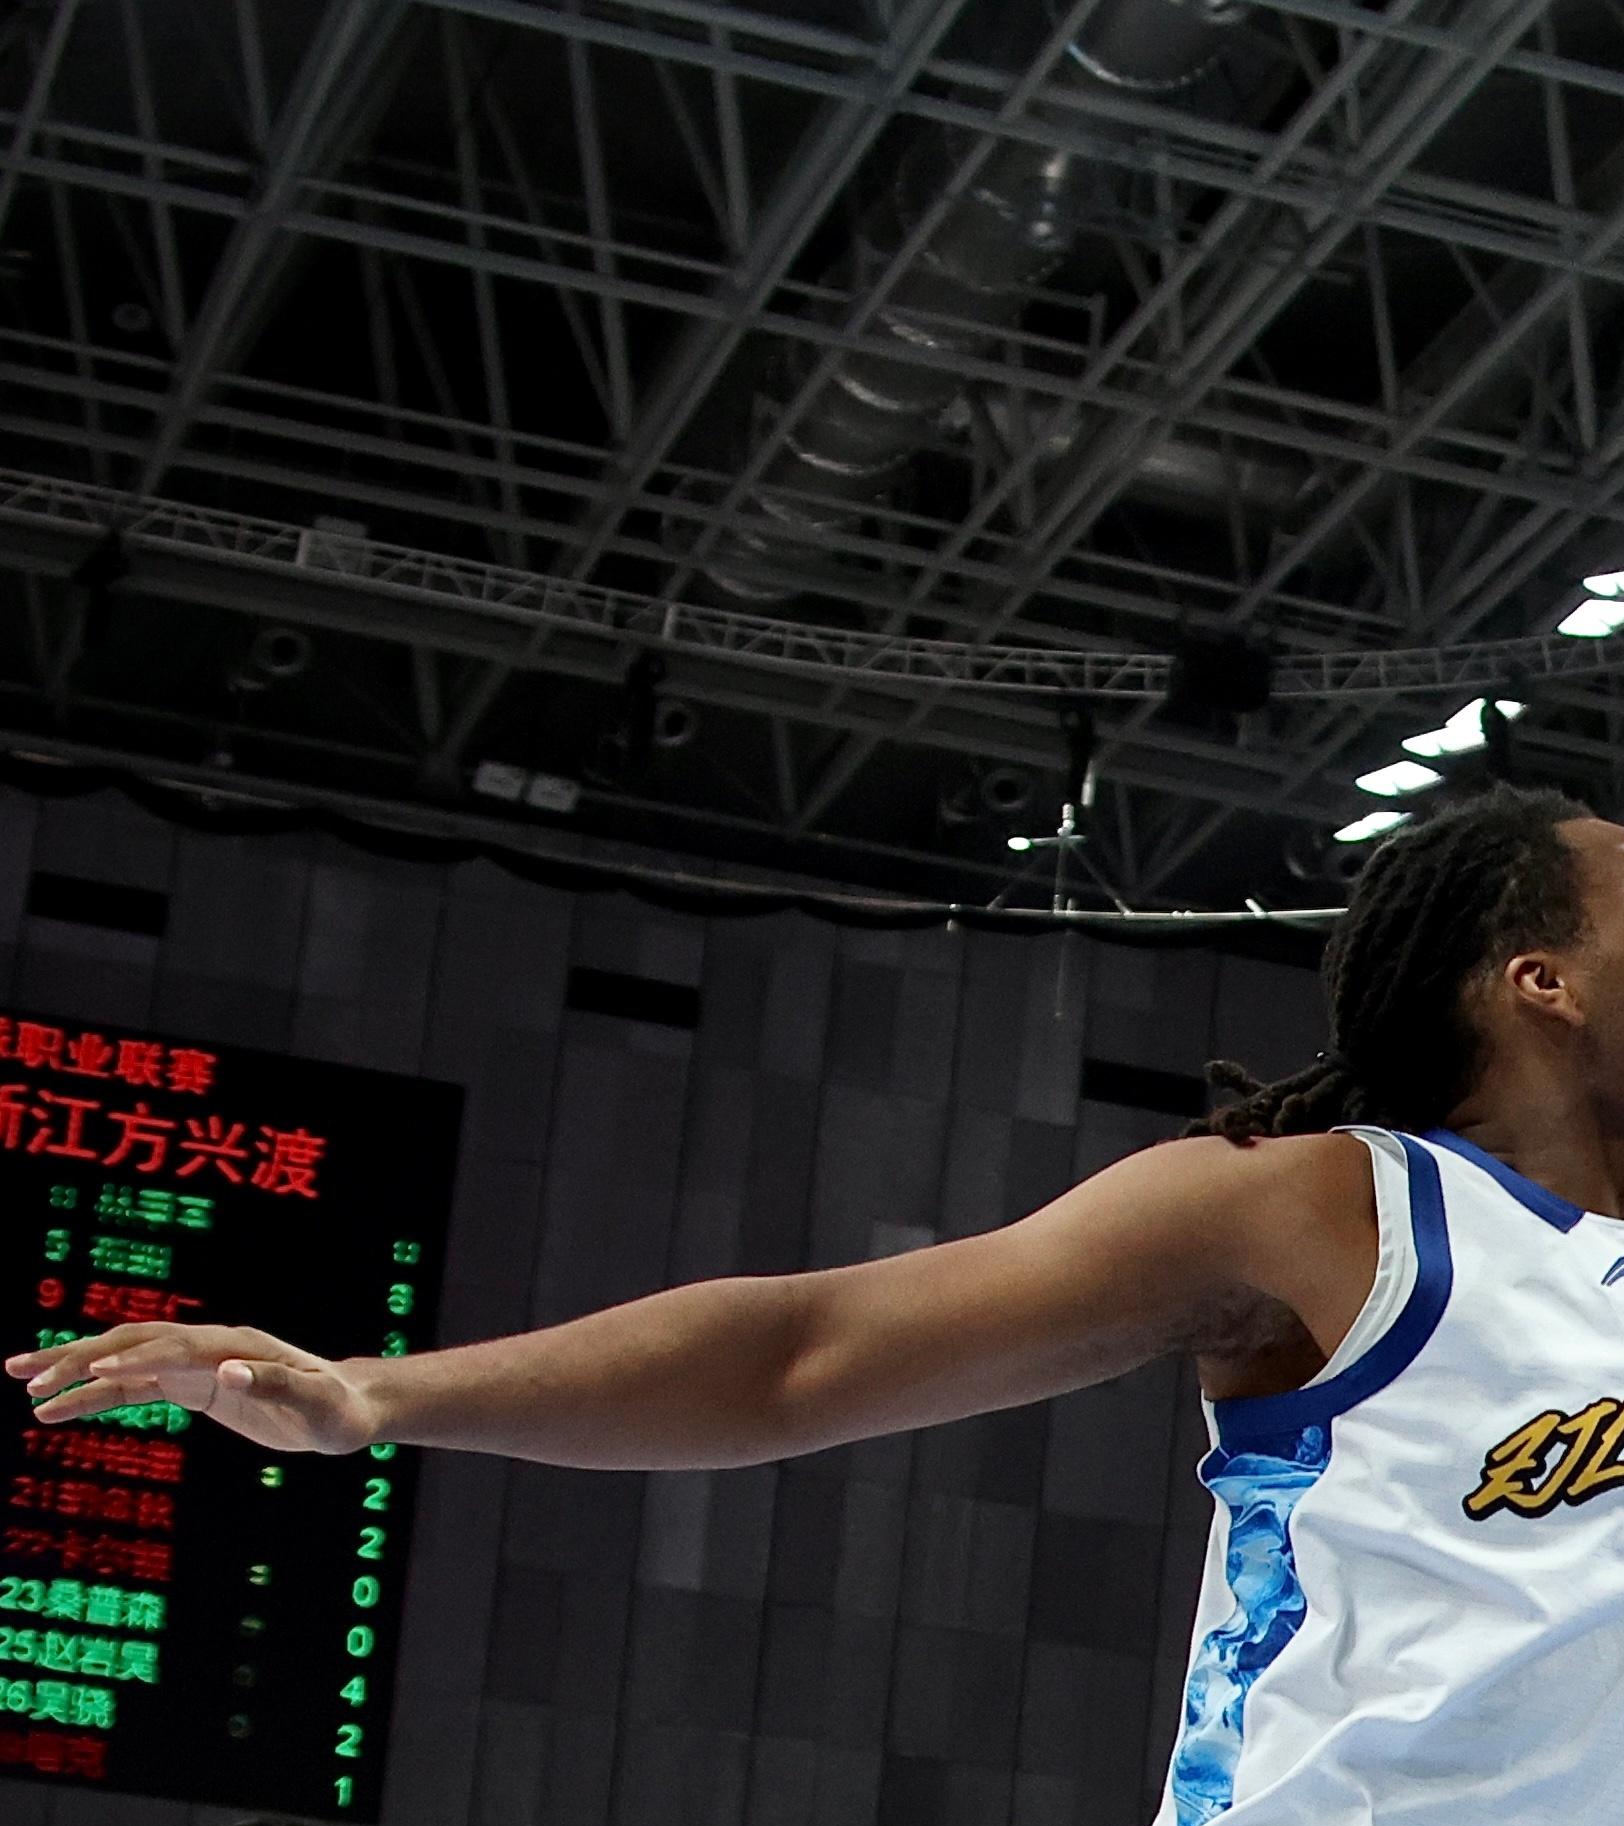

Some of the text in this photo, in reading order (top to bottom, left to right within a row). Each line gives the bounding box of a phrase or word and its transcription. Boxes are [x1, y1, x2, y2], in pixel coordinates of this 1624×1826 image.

[0, 1018, 216, 1095] 职业联赛
[363, 1478, 390, 1510] 2
[357, 1526, 385, 1559] 2
[352, 1576, 379, 1608] 0
[340, 1676, 366, 1707] 4
[335, 1724, 362, 1757] 2
[334, 1776, 352, 1806] 1
